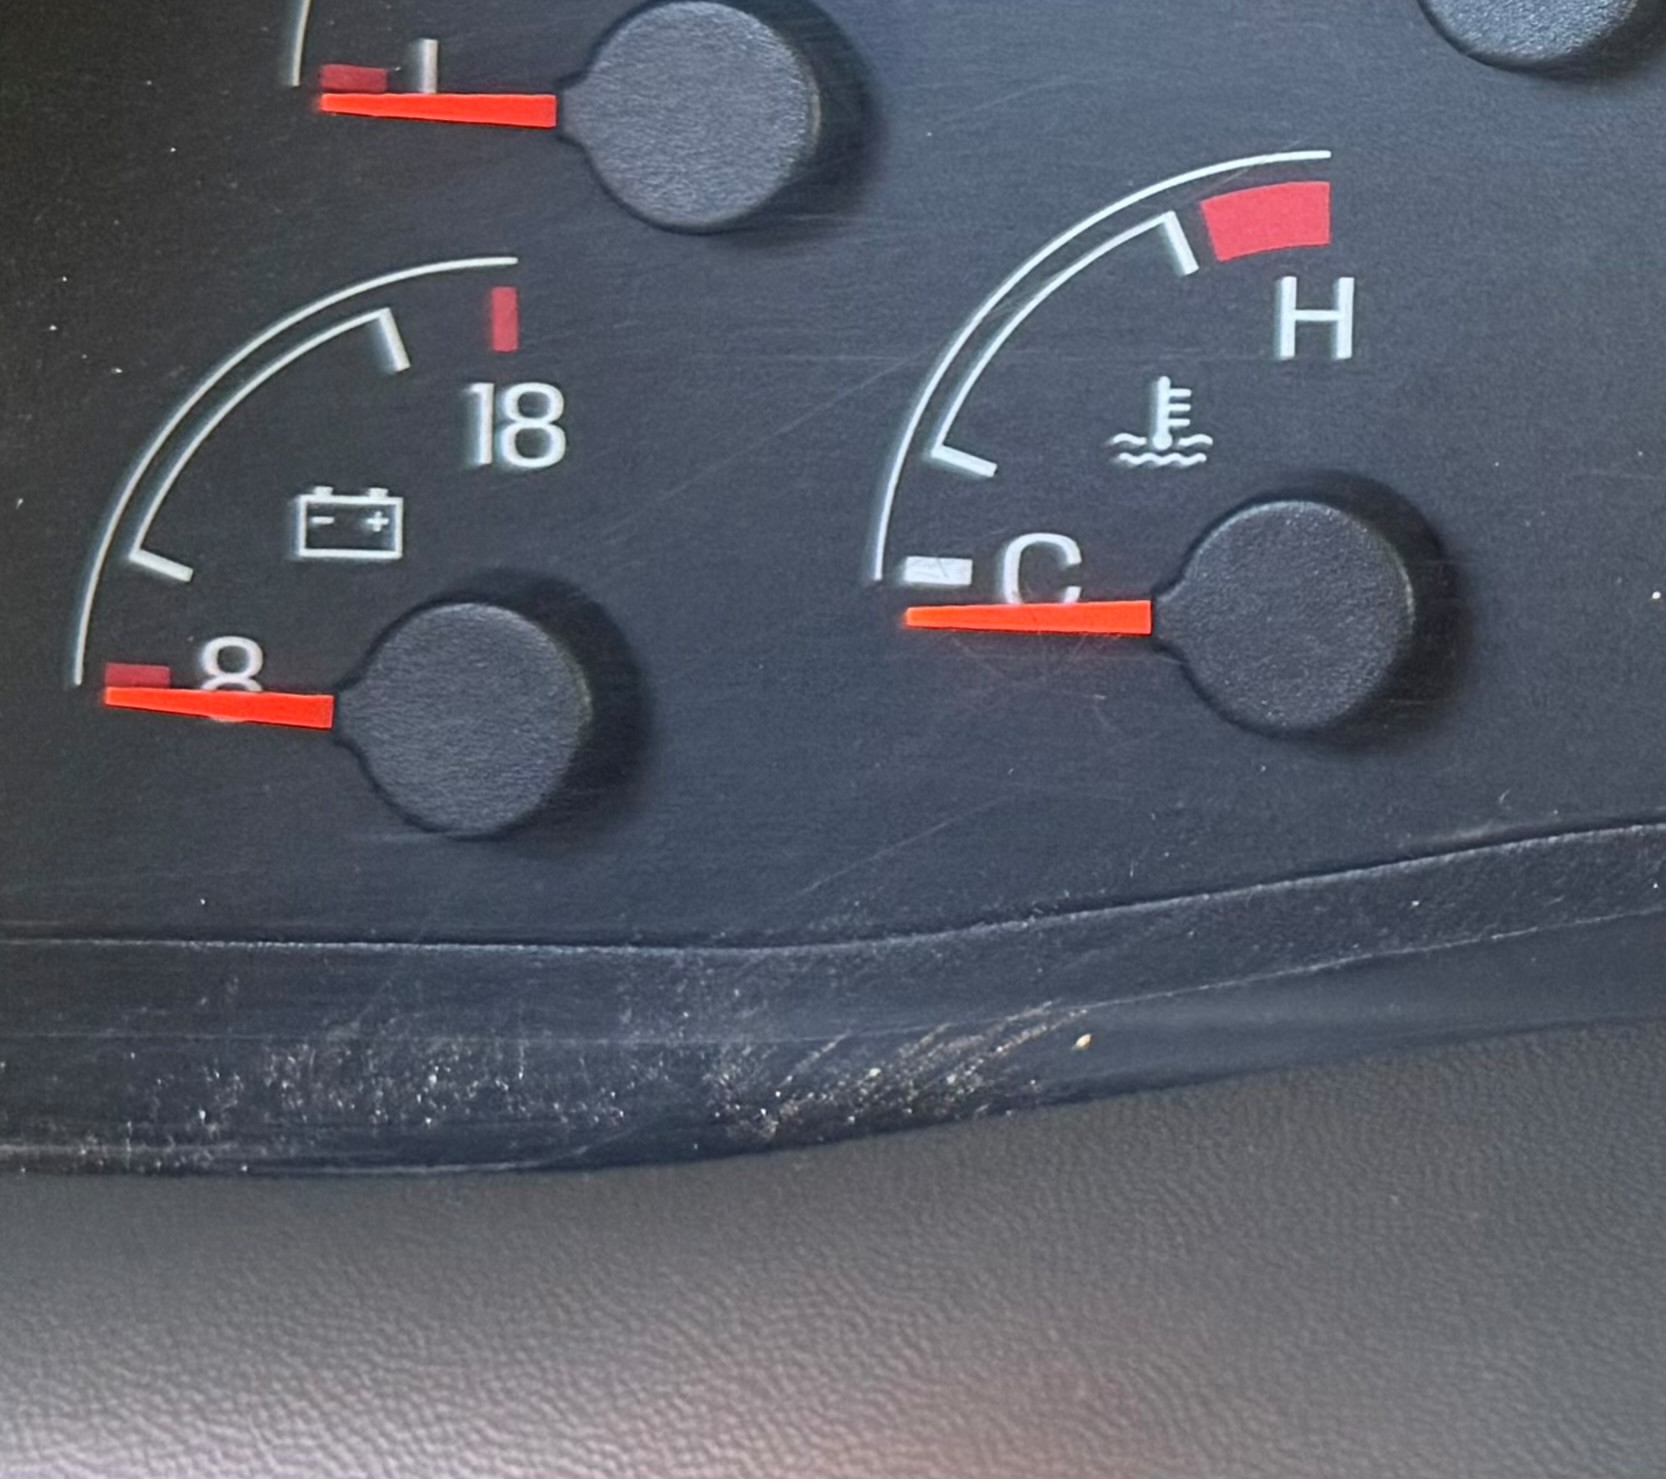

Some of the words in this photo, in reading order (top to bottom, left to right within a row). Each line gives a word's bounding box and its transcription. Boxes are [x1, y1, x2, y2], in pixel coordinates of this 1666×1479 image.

[1277, 274, 1356, 361] H
[468, 381, 566, 470] 18
[999, 531, 1083, 606] C
